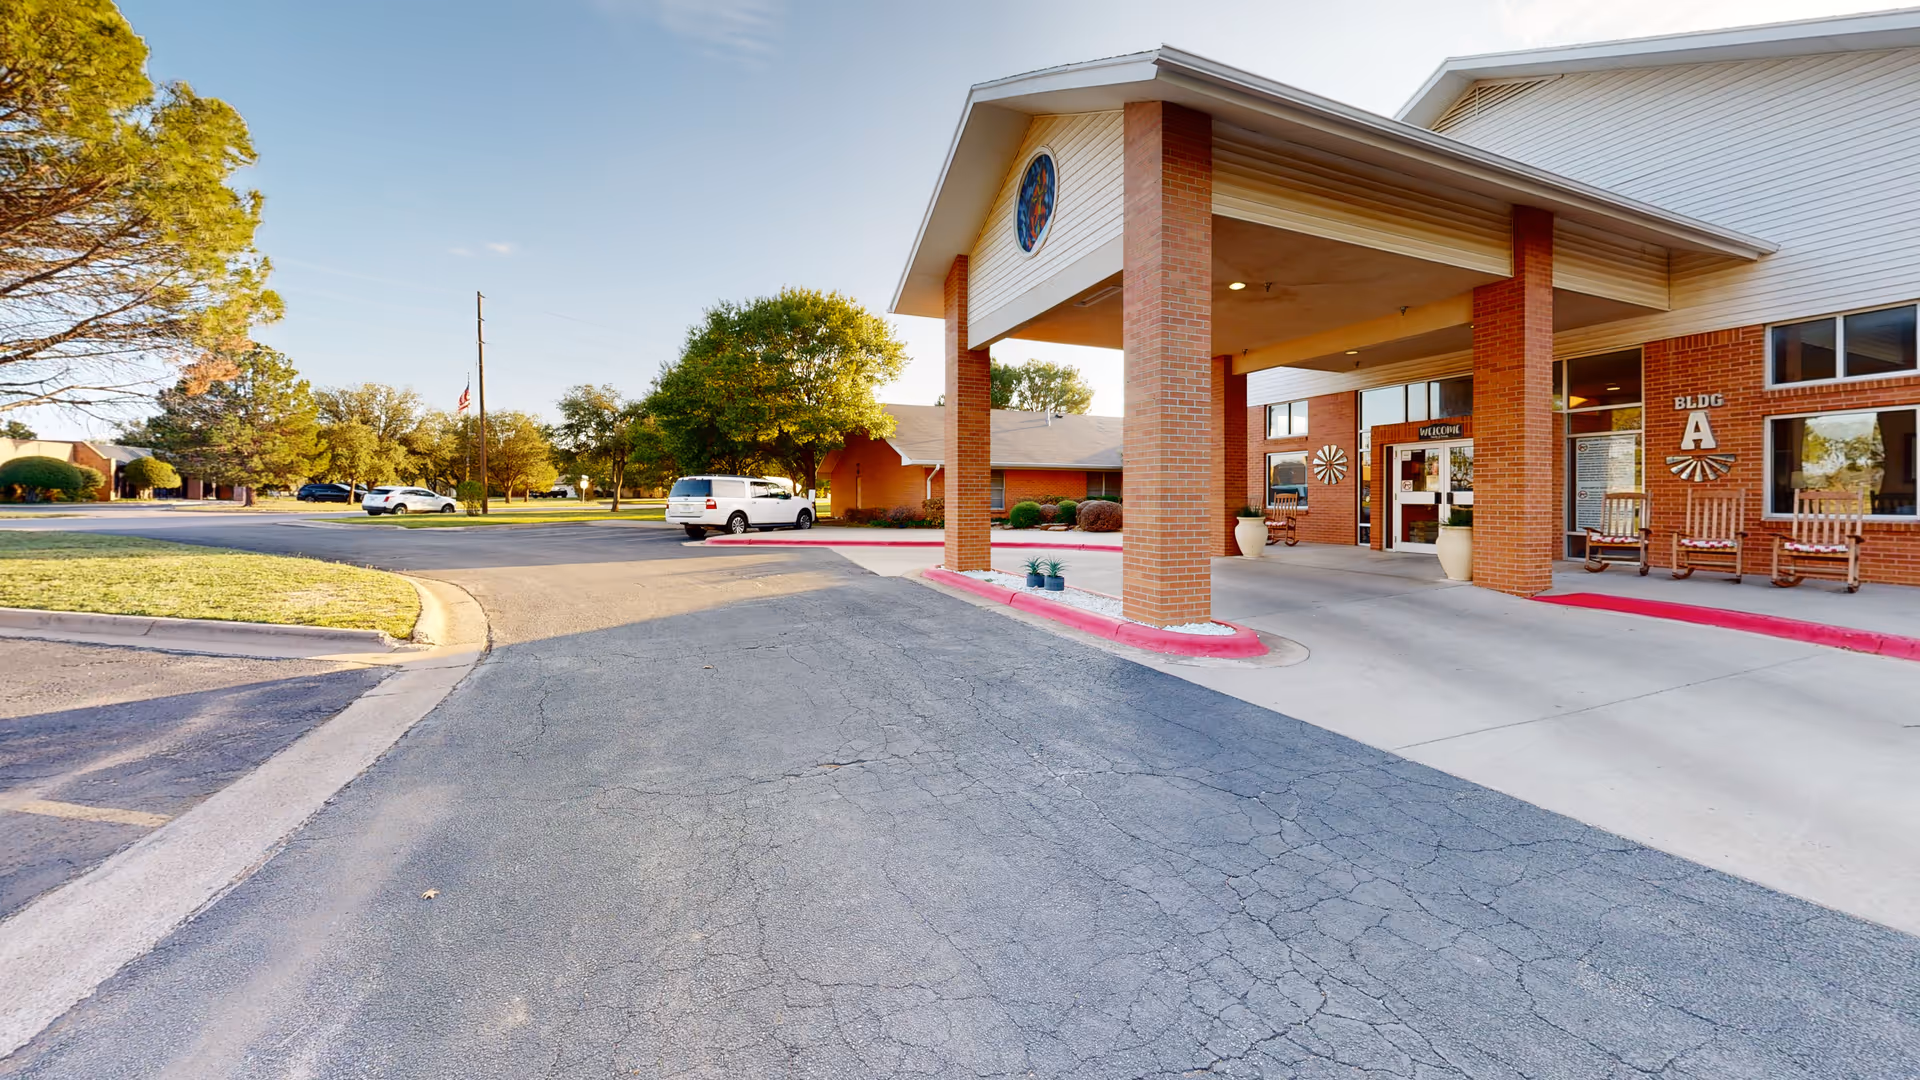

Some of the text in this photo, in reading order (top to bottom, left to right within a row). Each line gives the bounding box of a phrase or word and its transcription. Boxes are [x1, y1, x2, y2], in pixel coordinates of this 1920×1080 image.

[1674, 394, 1724, 410] BLDG
[1420, 425, 1460, 436] WELCOME
[1681, 411, 1717, 450] A
